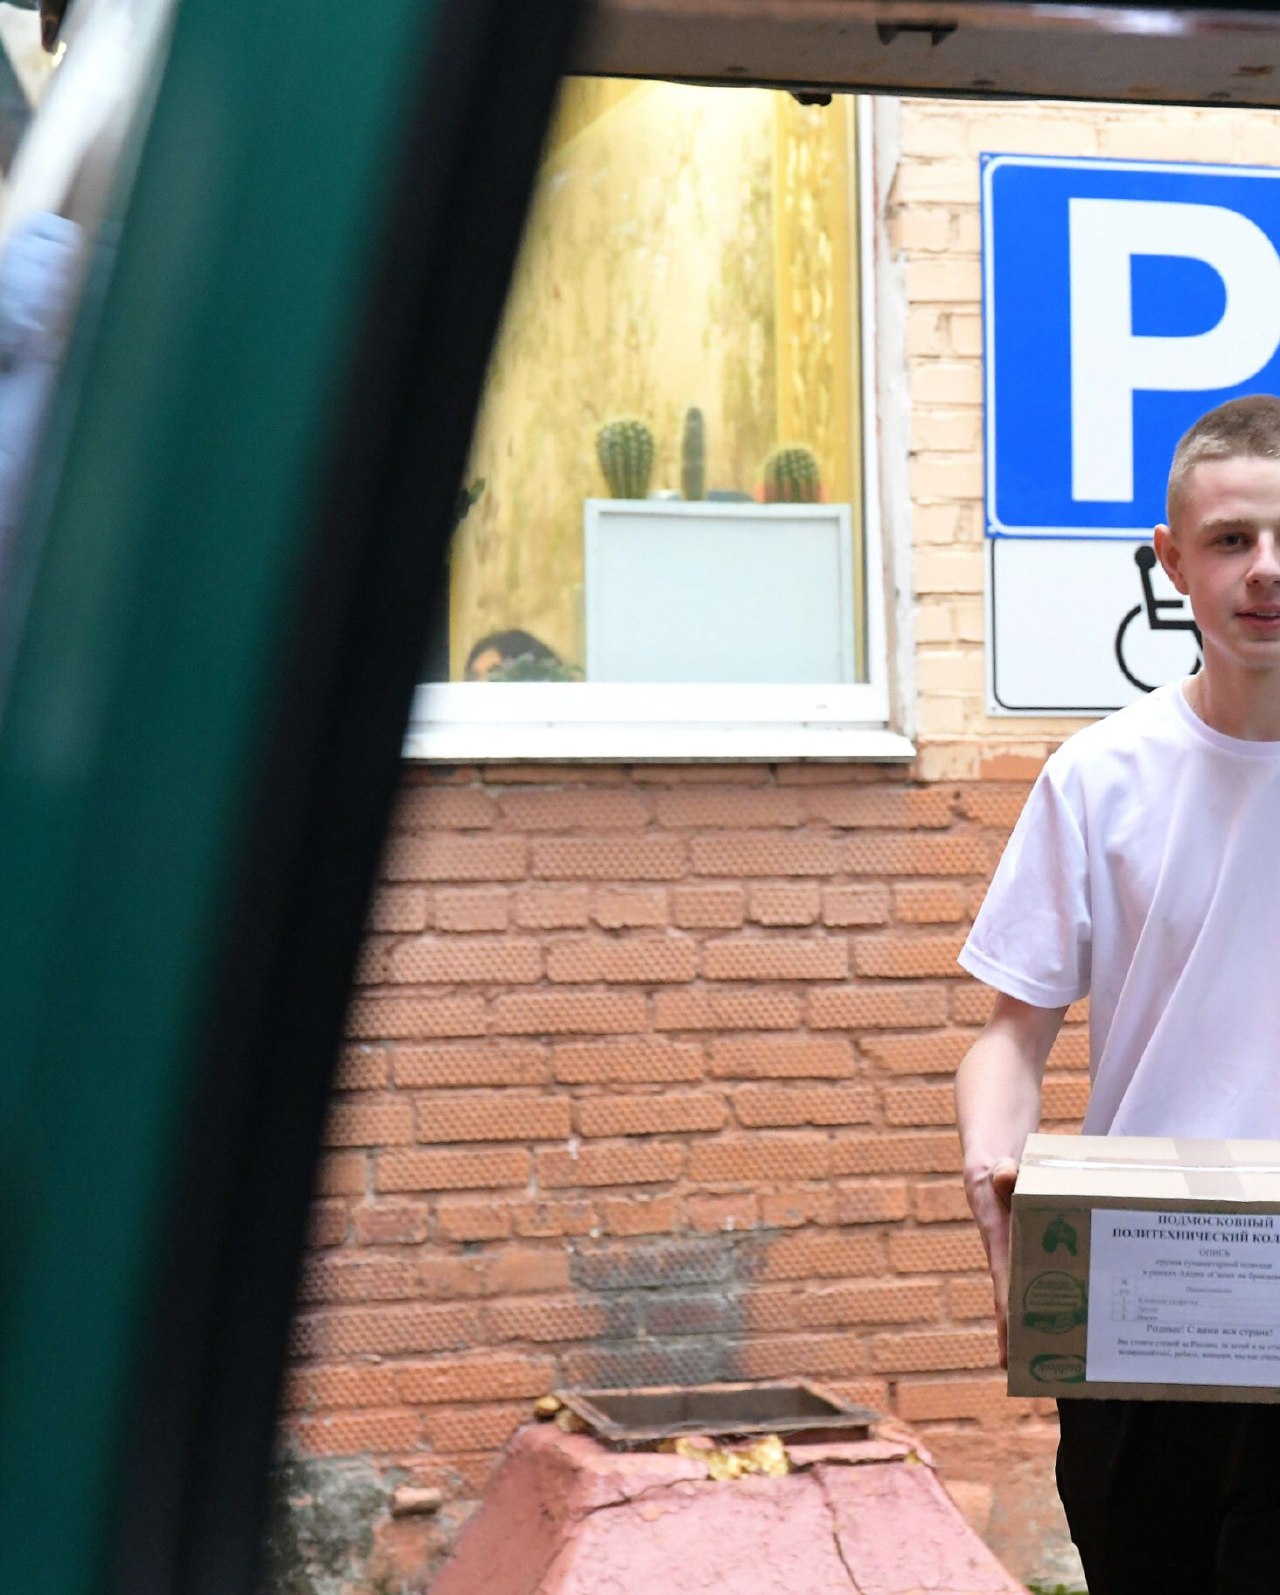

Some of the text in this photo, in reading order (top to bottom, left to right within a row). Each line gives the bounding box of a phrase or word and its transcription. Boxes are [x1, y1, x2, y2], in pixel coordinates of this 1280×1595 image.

[1158, 1214, 1274, 1229] ПОДМОСКОВНЫЙ
[1112, 1227, 1249, 1243] ПОЛИТЕХНИЧЕСКИЙ
[1198, 1248, 1231, 1258] ОПИСЬ
[1184, 1260, 1238, 1270] гуманитарной
[1146, 1323, 1274, 1339] Родные! С вами вся страна!
